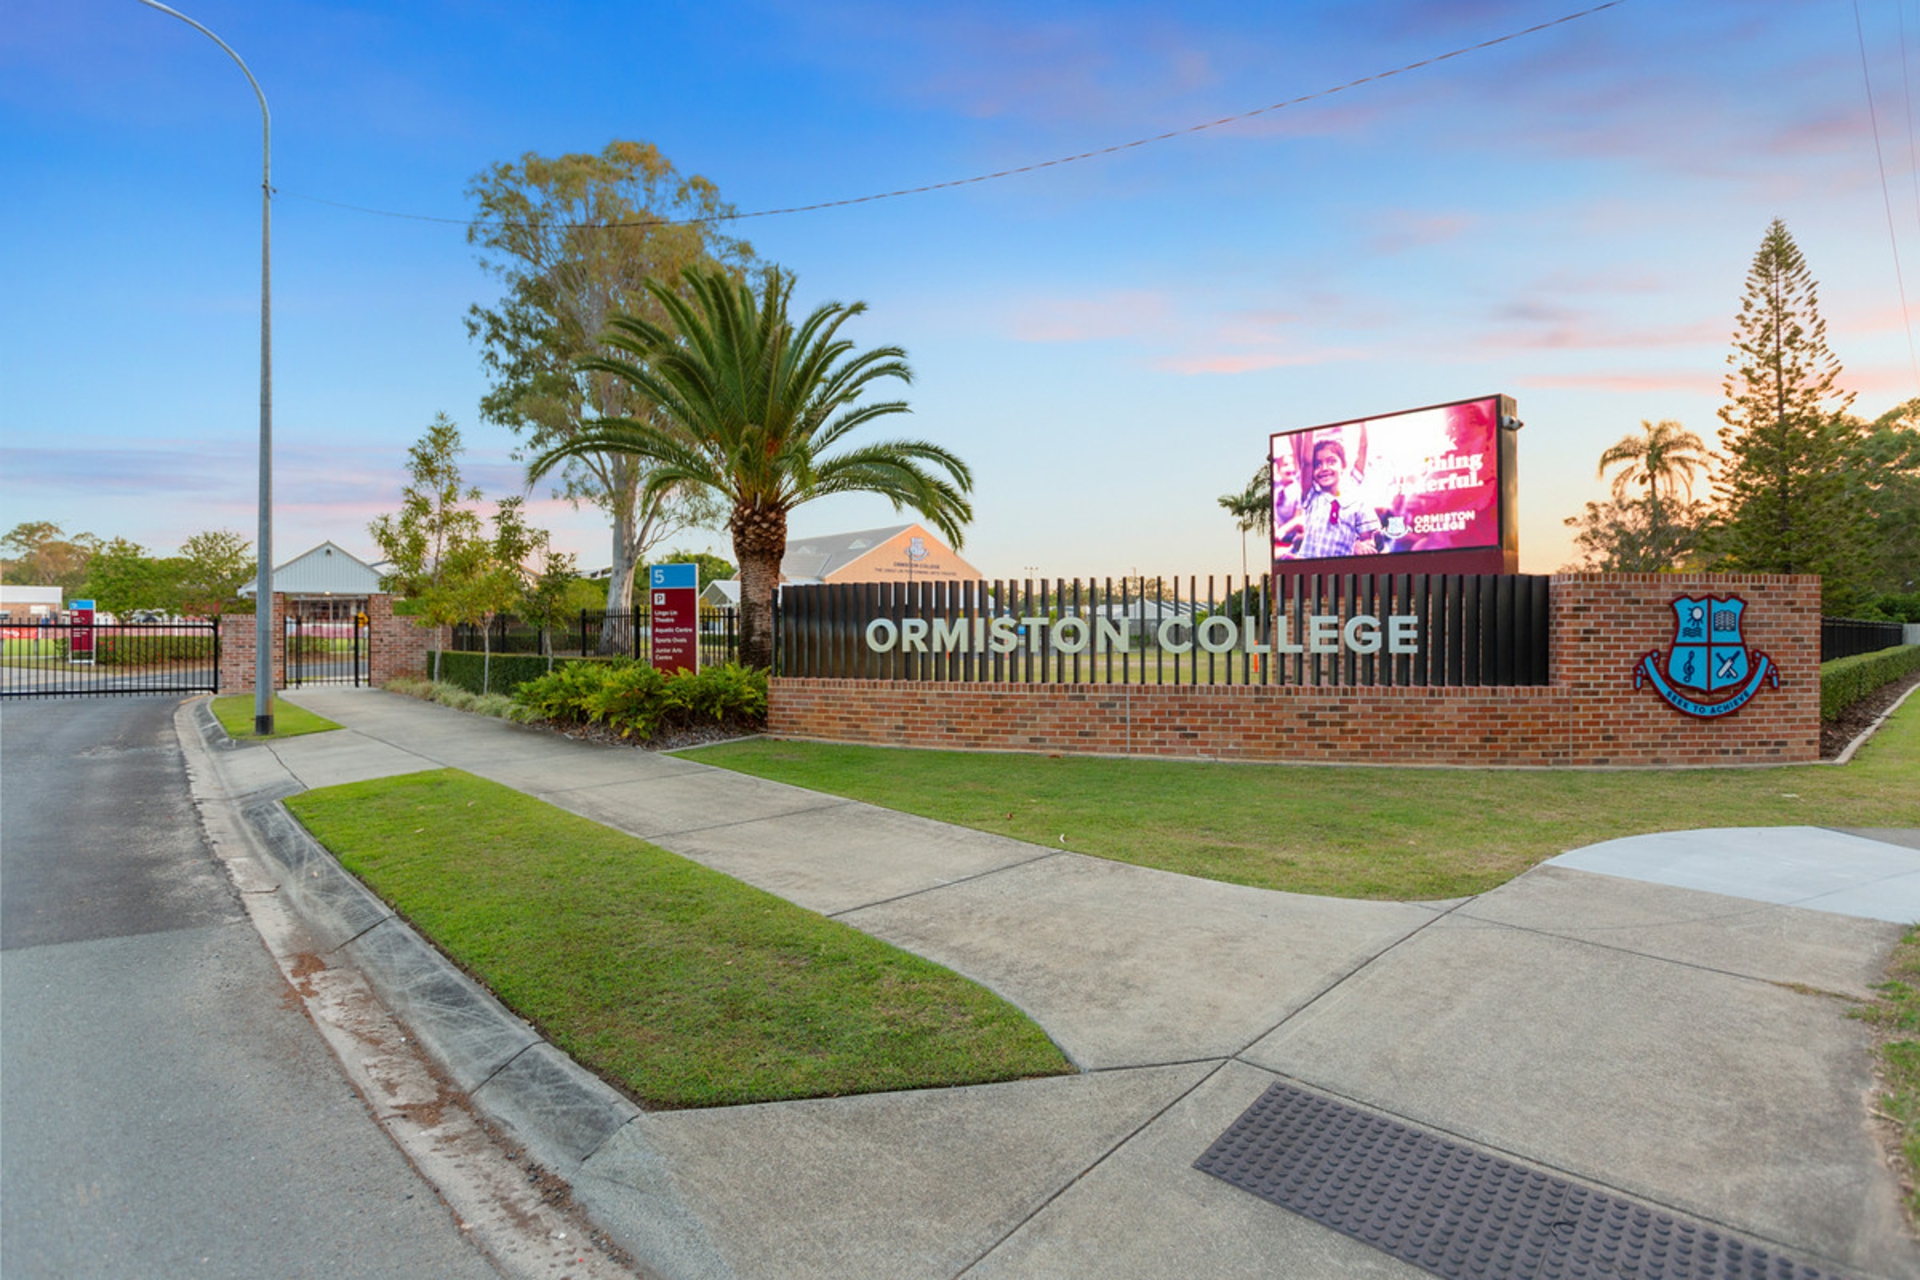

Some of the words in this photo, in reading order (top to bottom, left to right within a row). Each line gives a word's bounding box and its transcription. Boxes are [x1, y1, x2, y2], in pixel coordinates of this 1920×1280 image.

[1414, 510, 1476, 525] ORMISTON
[1414, 520, 1466, 533] COLLEGE
[654, 569, 665, 584] 5
[865, 616, 1129, 654] ORMISTON
[1158, 615, 1419, 654] COLLEGE
[1666, 690, 1688, 710] SEEK
[1693, 705, 1706, 714] TO
[1710, 690, 1750, 714] ACHIEVE
